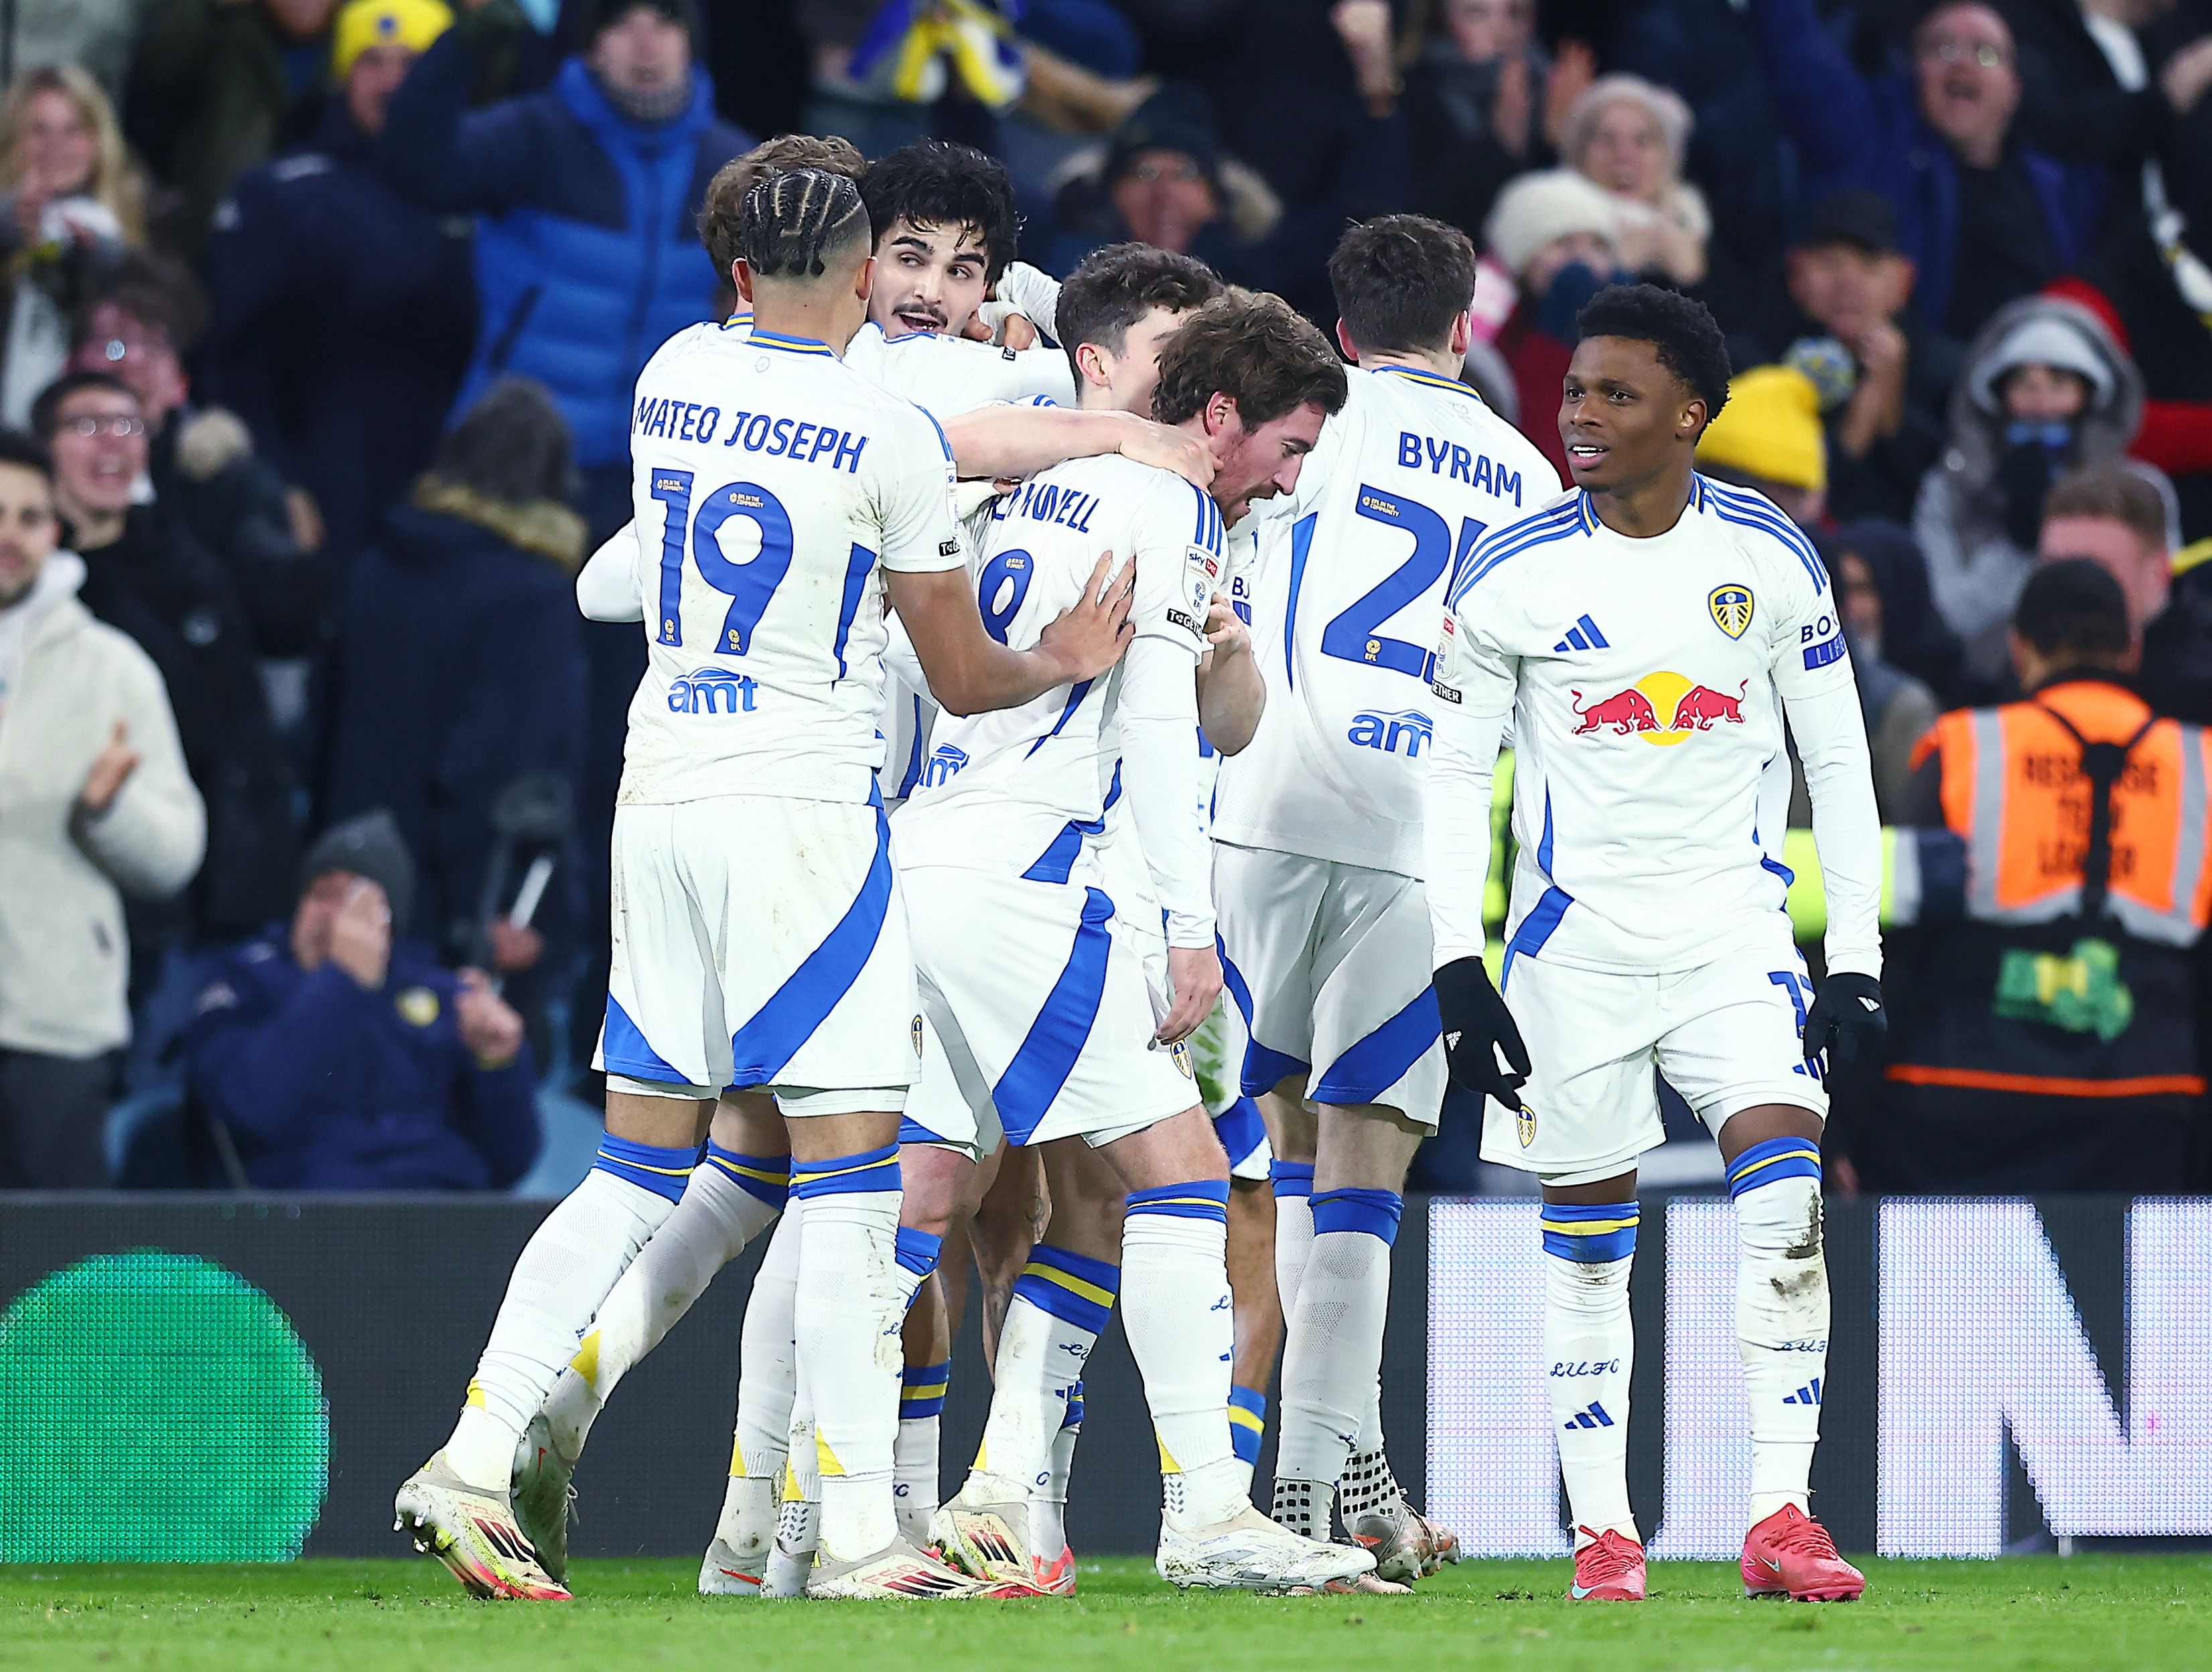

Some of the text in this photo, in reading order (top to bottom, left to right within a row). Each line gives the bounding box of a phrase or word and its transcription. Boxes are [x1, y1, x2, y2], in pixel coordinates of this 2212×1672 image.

[634, 395, 870, 473] MATEO JOSEPH
[1398, 431, 1522, 508] BYRAM
[650, 468, 794, 656] 19
[1189, 553, 1205, 566] sky
[1320, 483, 1489, 685] 2
[1365, 652, 1377, 662] EFL
[667, 675, 759, 714] amt
[1550, 1358, 1620, 1378] LUFC
